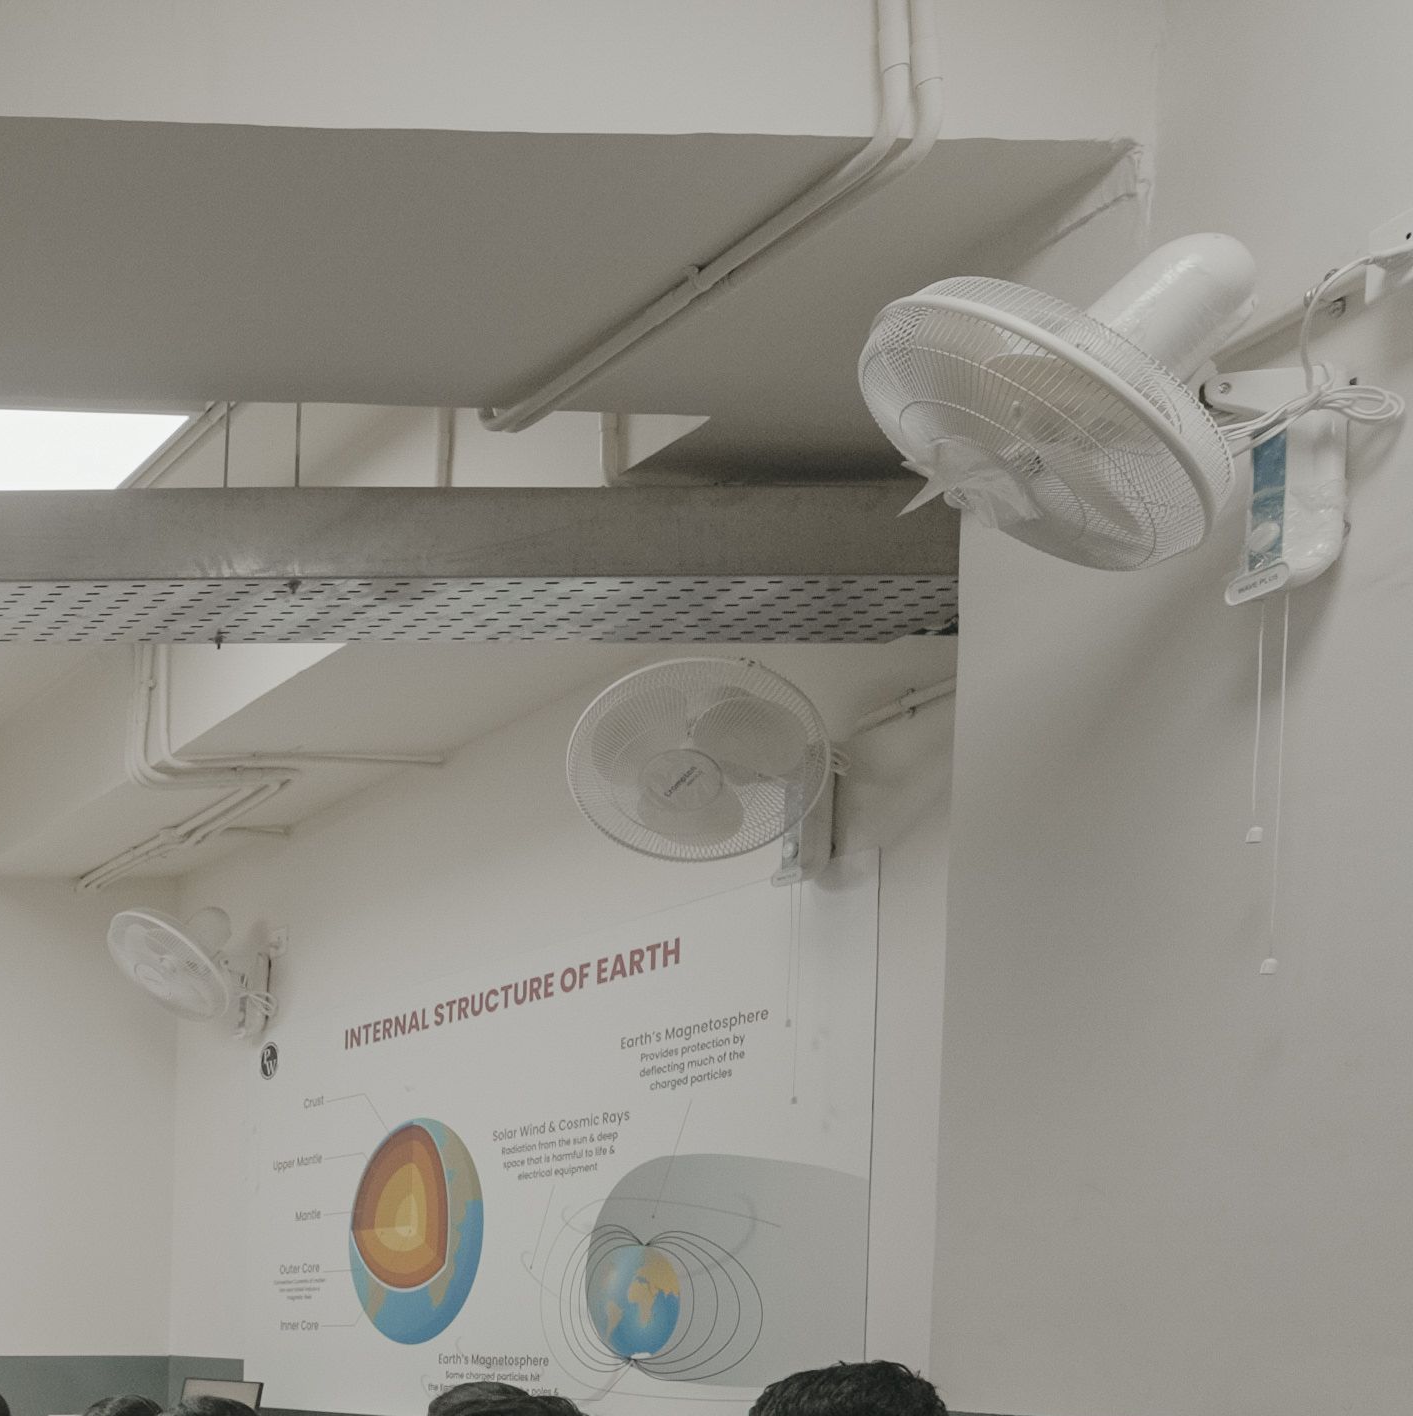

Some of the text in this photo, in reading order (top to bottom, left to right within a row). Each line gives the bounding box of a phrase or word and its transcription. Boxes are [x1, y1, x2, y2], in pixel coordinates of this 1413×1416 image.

[344, 937, 681, 1050] INTERNAL STRUCTURE OF EARTH
[620, 1008, 769, 1050] Earth's Magnetosphere
[640, 1033, 745, 1063] Provides protection by
[639, 1050, 745, 1078] deflecting much of the
[649, 1068, 733, 1091] charged particles
[303, 1096, 324, 1109] Crust
[492, 1110, 630, 1142] Solar Wind & Cosmic Rays
[501, 1130, 618, 1156] Radiation from the sun & deep
[273, 1154, 322, 1173] Upper Mantle
[503, 1156, 525, 1170] space
[527, 1154, 542, 1166] that
[544, 1154, 550, 1164] is
[552, 1148, 583, 1163] harmful
[585, 1148, 593, 1157] to
[595, 1146, 608, 1156] life
[517, 1162, 597, 1180] electrical equipment
[295, 1208, 321, 1221] Mantle
[280, 1263, 320, 1274] Outer Core
[280, 1320, 319, 1331] Inner Core
[438, 1353, 549, 1369] Earth's Magnetosphere
[445, 1370, 540, 1383] Some charged particles hit
